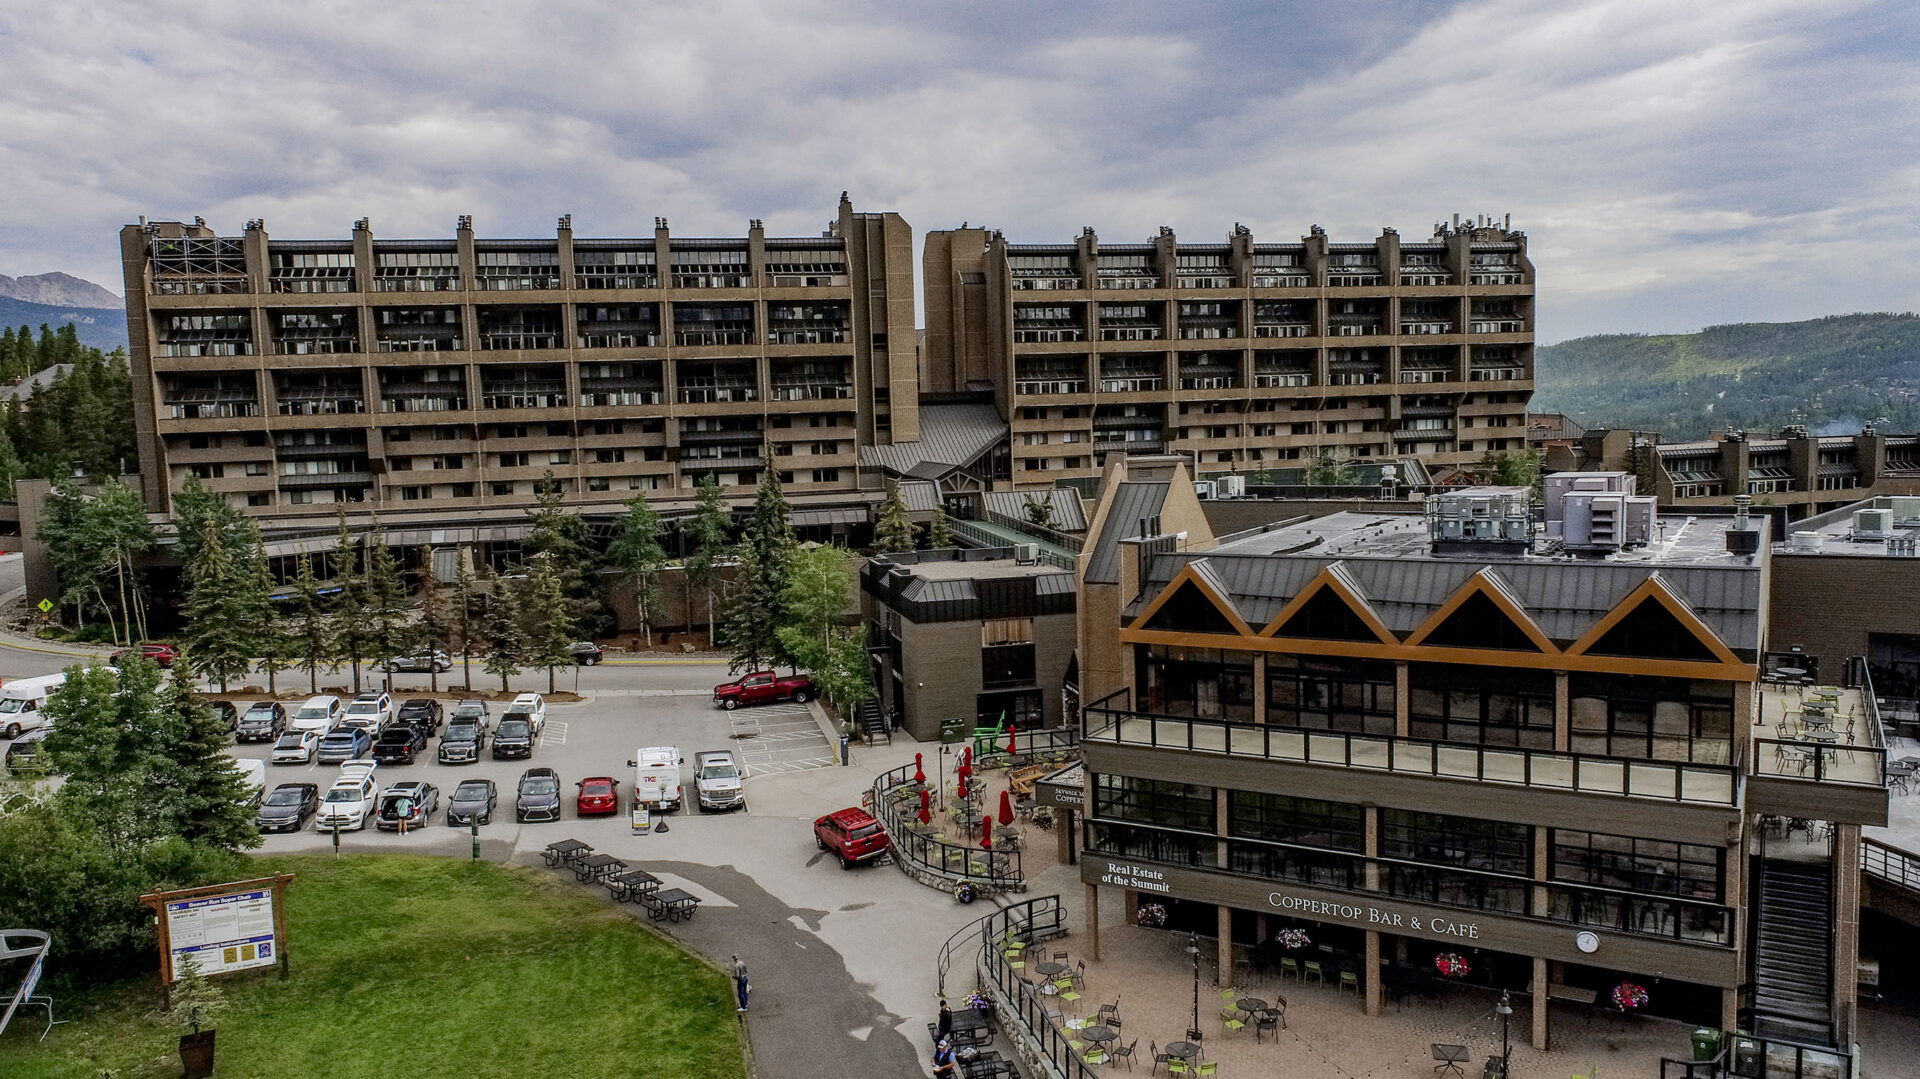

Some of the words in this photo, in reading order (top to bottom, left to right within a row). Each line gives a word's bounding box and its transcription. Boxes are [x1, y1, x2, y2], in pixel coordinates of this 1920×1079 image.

[1055, 794, 1084, 804] COPPERT
[1108, 863, 1130, 875] Real
[1132, 867, 1163, 880] Estate
[1102, 874, 1112, 883] of
[1114, 876, 1129, 886] the
[1130, 878, 1170, 893] Summit
[1268, 892, 1362, 920] COPPERTOP
[1368, 908, 1403, 927] BAR
[1410, 916, 1422, 930] &
[1430, 918, 1479, 939] CAFÉ
